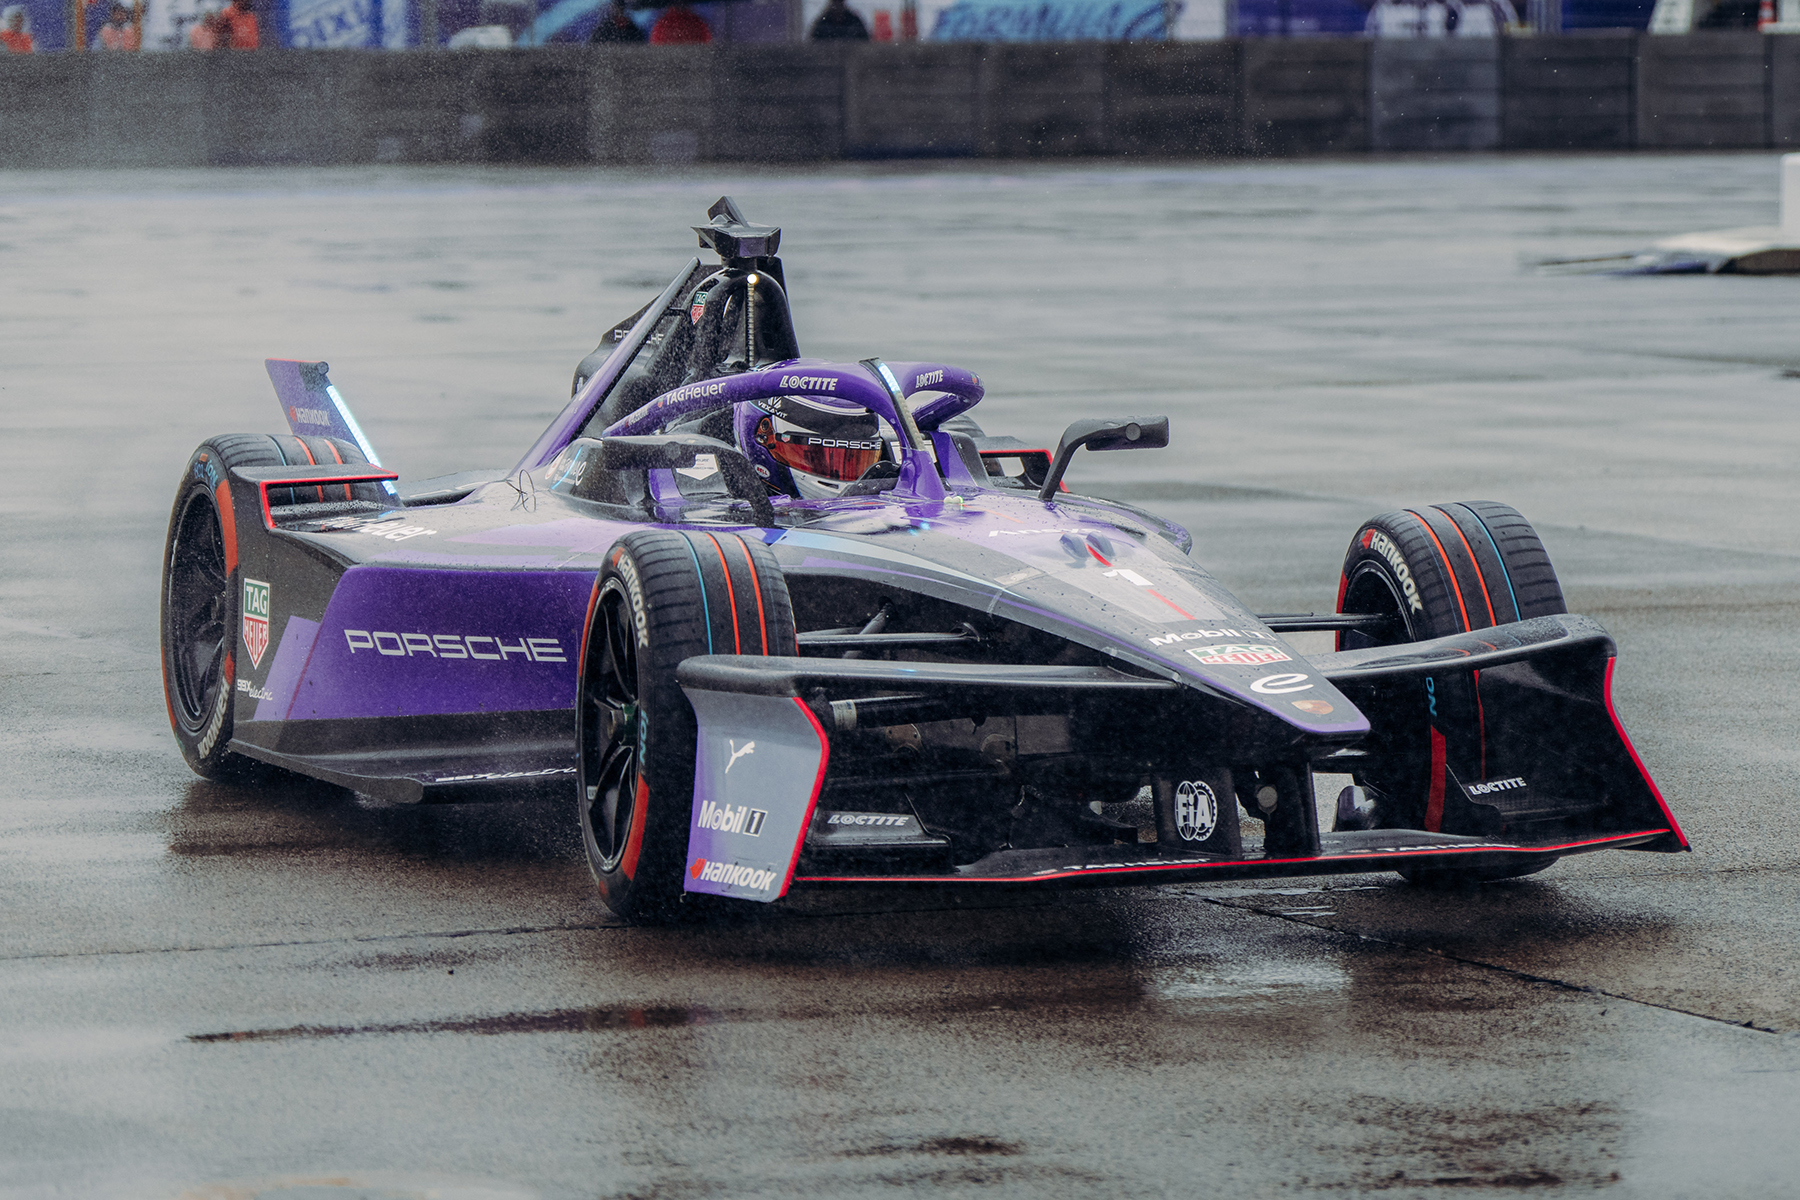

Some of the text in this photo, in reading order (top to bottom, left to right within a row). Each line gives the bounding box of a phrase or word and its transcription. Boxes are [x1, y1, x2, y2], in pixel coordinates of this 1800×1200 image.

[779, 375, 838, 391] LOCTITE
[915, 369, 944, 389] LOCTITE
[808, 437, 882, 450] PORSCHE
[1102, 568, 1154, 586] 1
[246, 586, 267, 615] TAG
[244, 620, 267, 661] HEUER
[344, 629, 568, 662] PORSCHE
[1148, 628, 1242, 647] Mobil
[1468, 776, 1527, 795] LOCTITE
[697, 800, 748, 834] Mobil
[827, 814, 909, 826] LOCTITE
